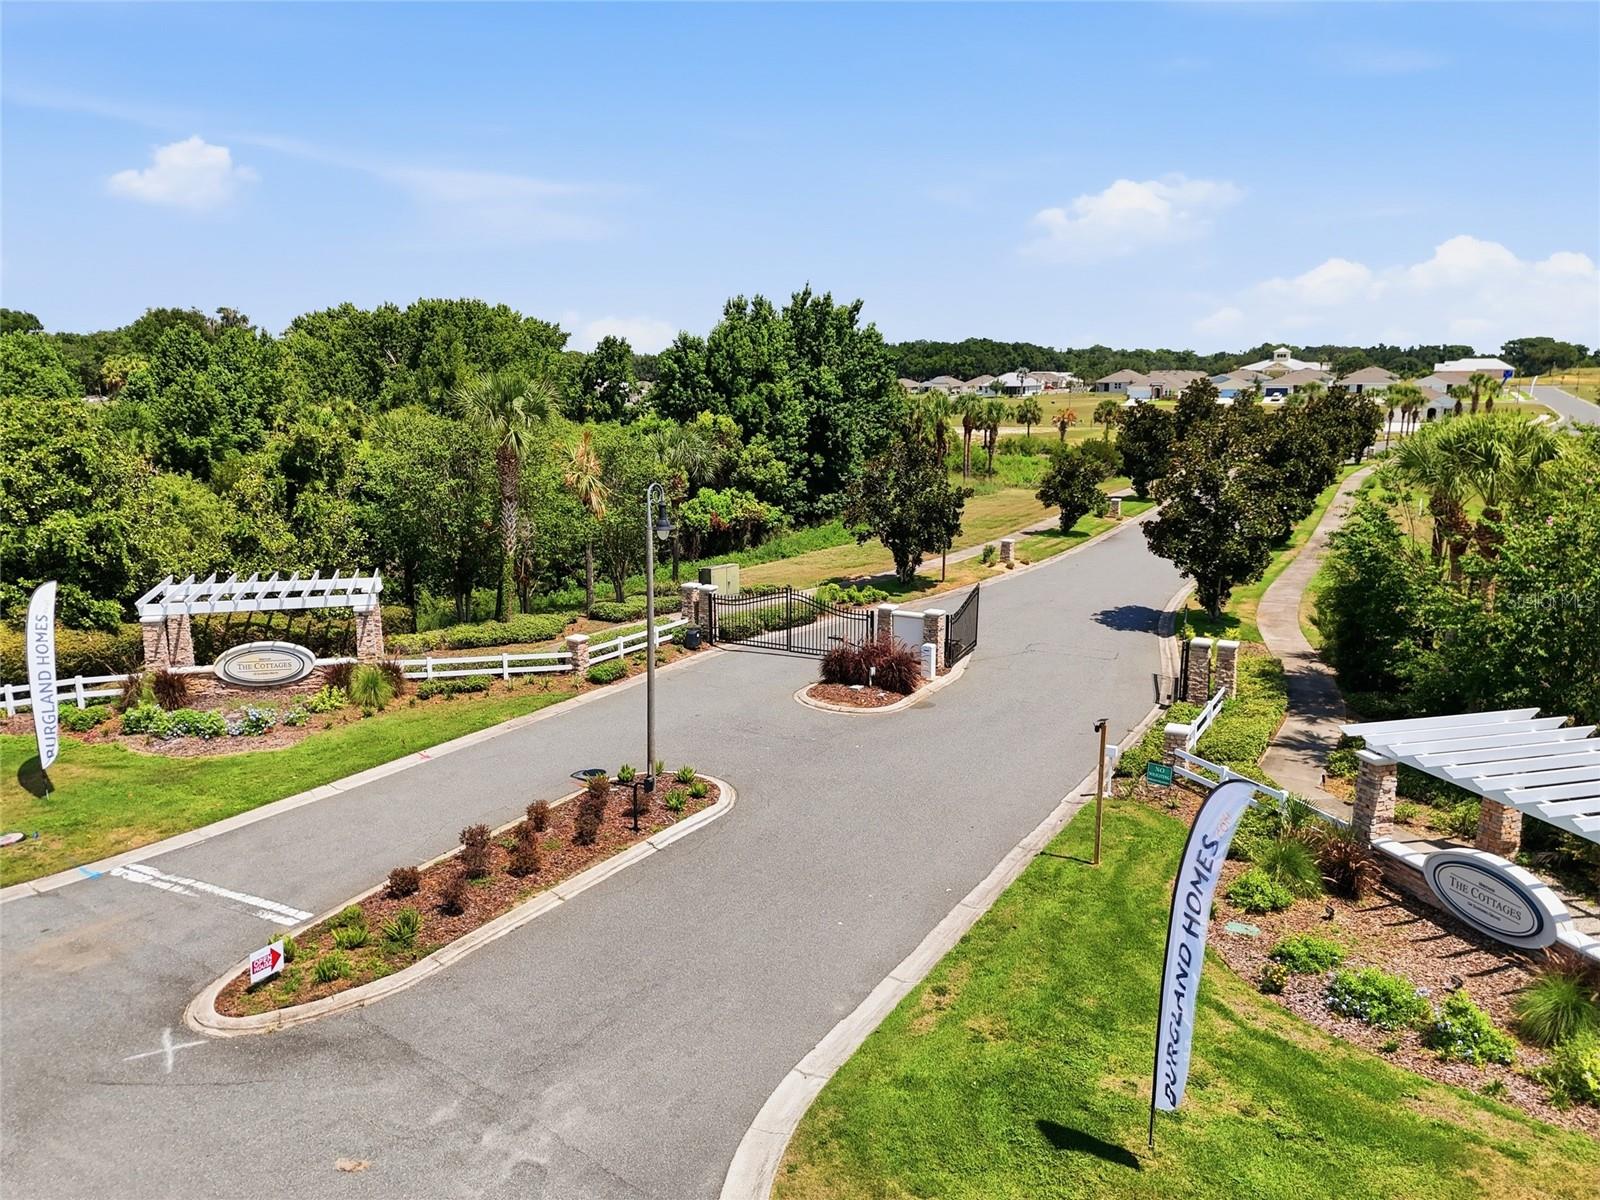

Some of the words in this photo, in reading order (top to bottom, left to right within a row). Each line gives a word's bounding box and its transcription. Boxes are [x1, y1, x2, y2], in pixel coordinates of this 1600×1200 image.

[35, 614, 50, 665] HOMES
[237, 663, 253, 671] THE
[254, 662, 292, 670] COTTAGES
[38, 670, 57, 758] BURGLAND
[1154, 766, 1165, 774] NO
[1449, 875, 1469, 894] THE
[1470, 886, 1522, 921] COTTAGES
[1164, 942, 1192, 1107] BURGLAND
[1182, 834, 1219, 939] HOMES
